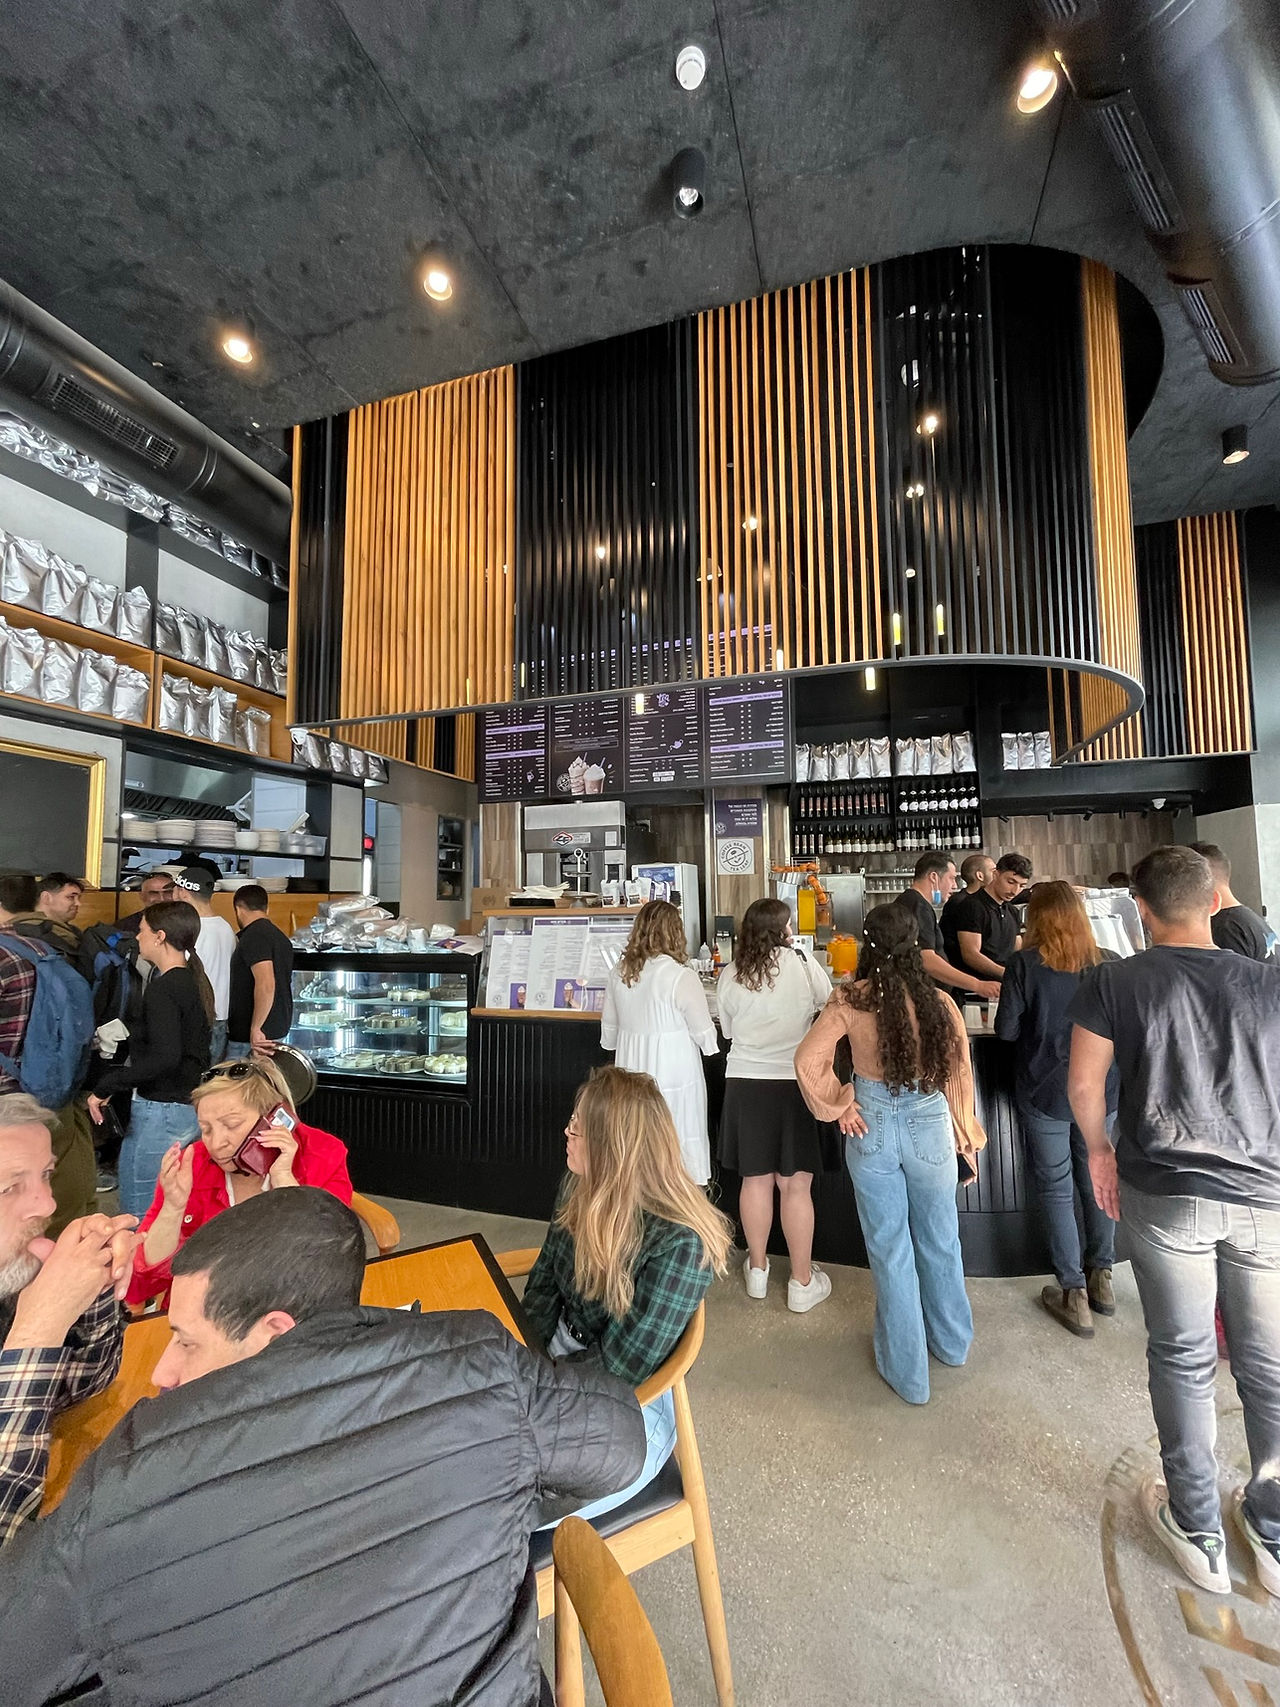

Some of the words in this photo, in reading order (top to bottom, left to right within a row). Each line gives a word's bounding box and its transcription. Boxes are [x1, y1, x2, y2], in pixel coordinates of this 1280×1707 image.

[721, 843, 732, 859] COFFEE
[733, 842, 747, 850] BEAN
[739, 859, 749, 870] LEAF
